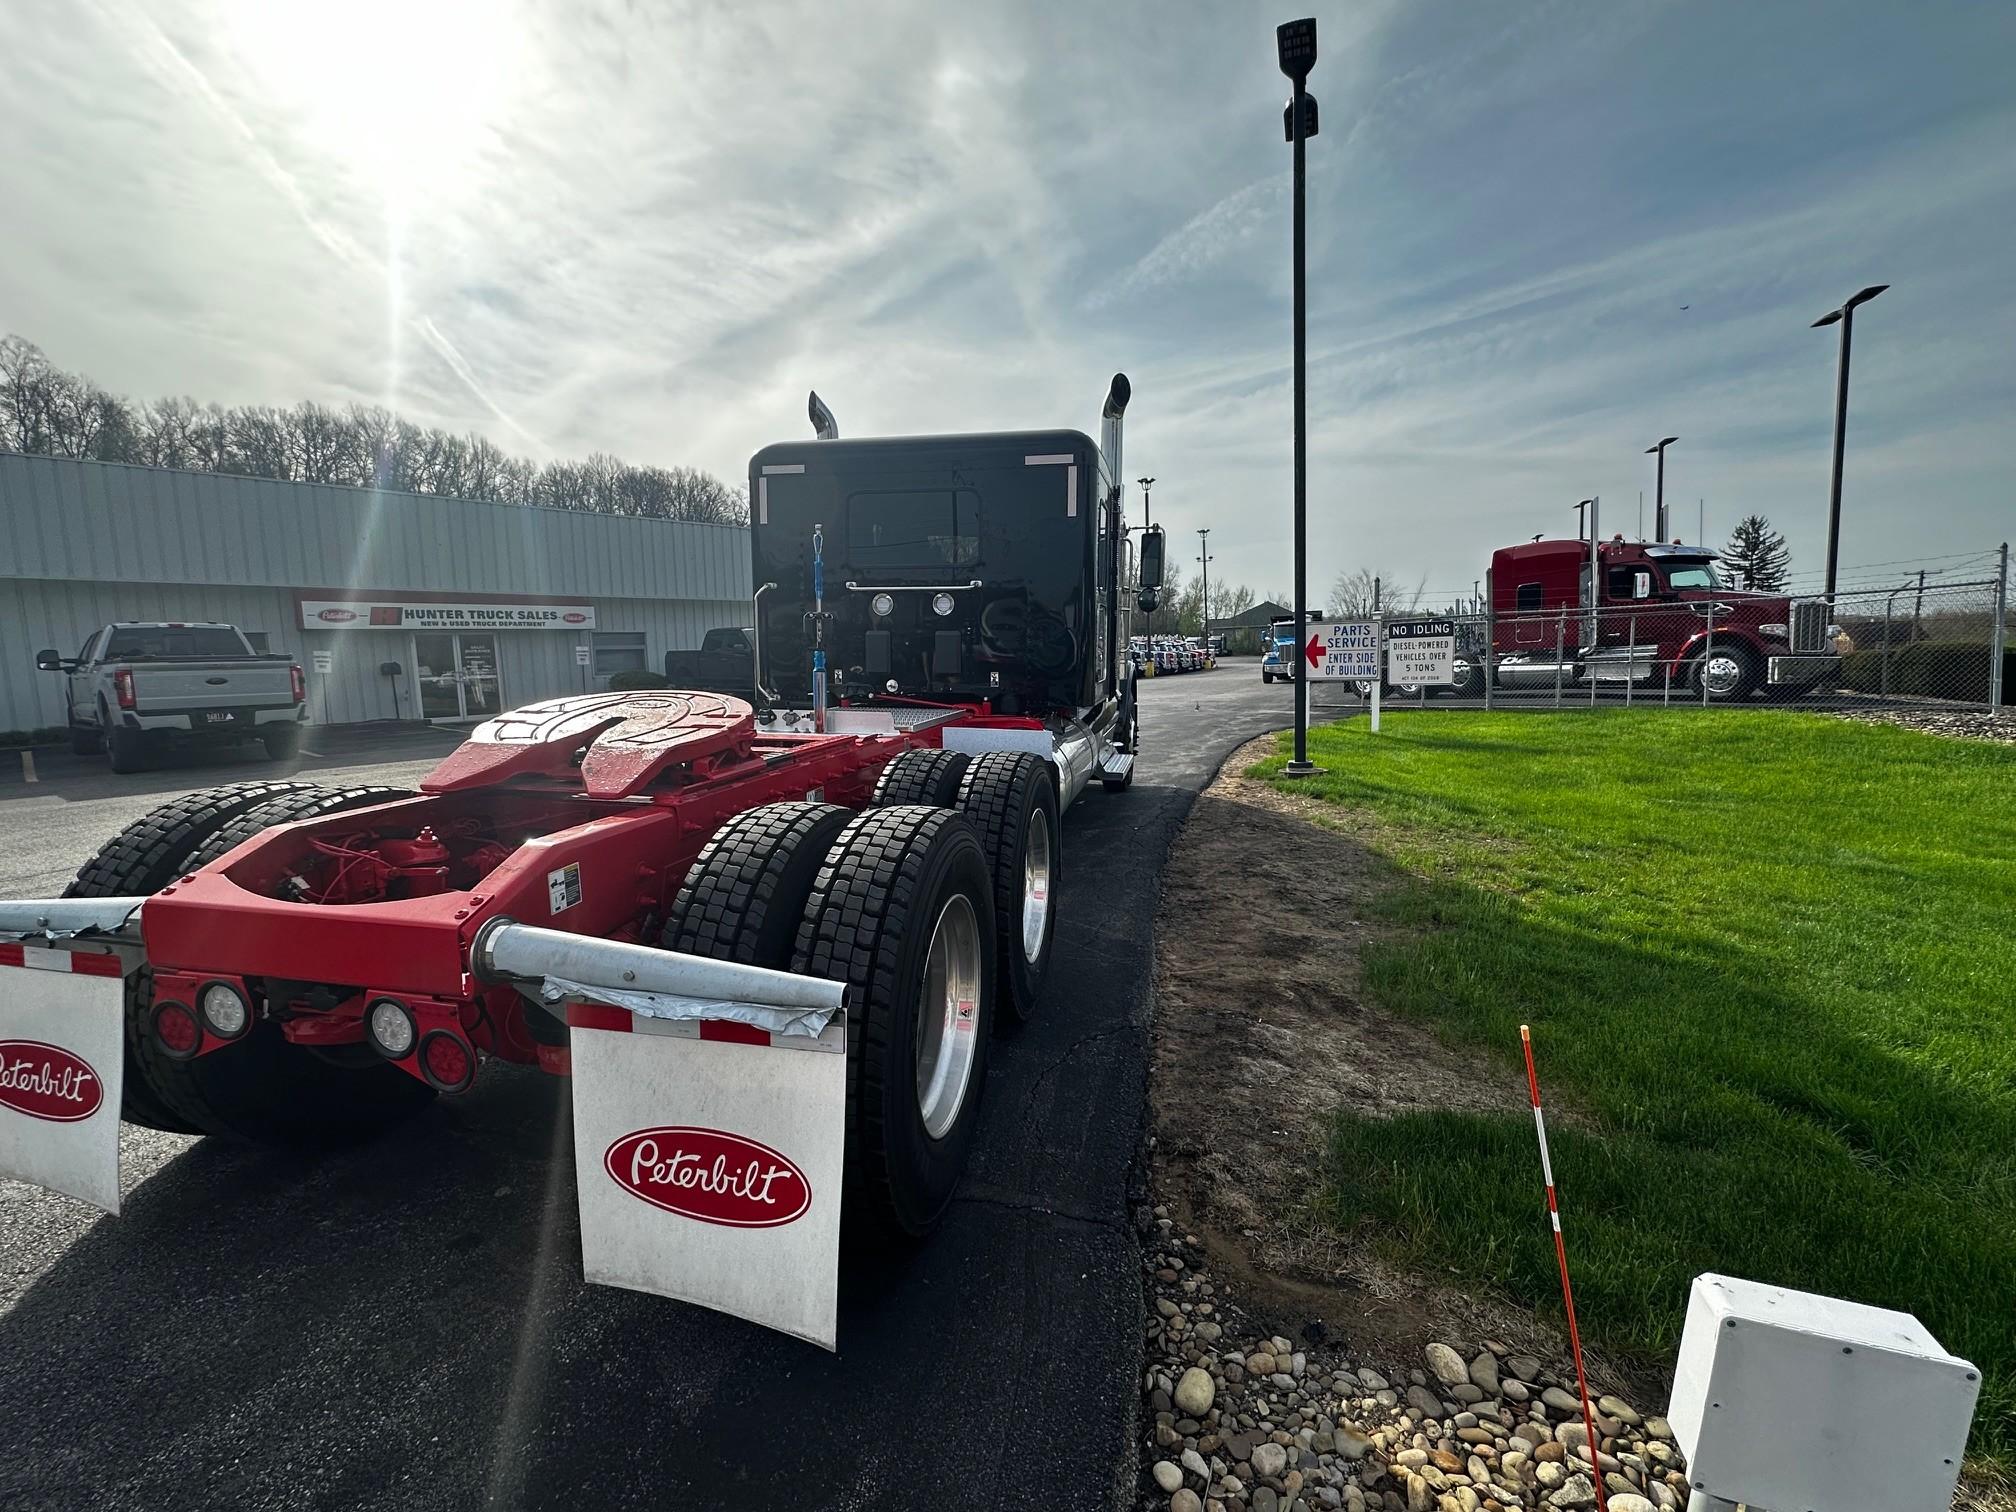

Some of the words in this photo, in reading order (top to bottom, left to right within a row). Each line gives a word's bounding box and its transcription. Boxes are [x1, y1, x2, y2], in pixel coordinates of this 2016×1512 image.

[404, 609, 464, 619] HUNTER
[467, 610, 514, 619] TRUCK
[517, 610, 557, 620] SALES
[1333, 625, 1370, 636] PARTS
[1392, 625, 1407, 635] NO
[1413, 623, 1450, 634] IDLING
[1327, 637, 1377, 648] SERVICE
[1393, 640, 1449, 650] DIESEL-POWERED
[1328, 653, 1353, 664] ENTER
[1356, 652, 1375, 663] SIDE
[1396, 653, 1426, 661] VEHICLES
[1429, 652, 1447, 660] OVER
[1325, 665, 1335, 675] OF
[1338, 665, 1377, 675] BUILDING
[631, 1139, 792, 1204] Peterbilt
